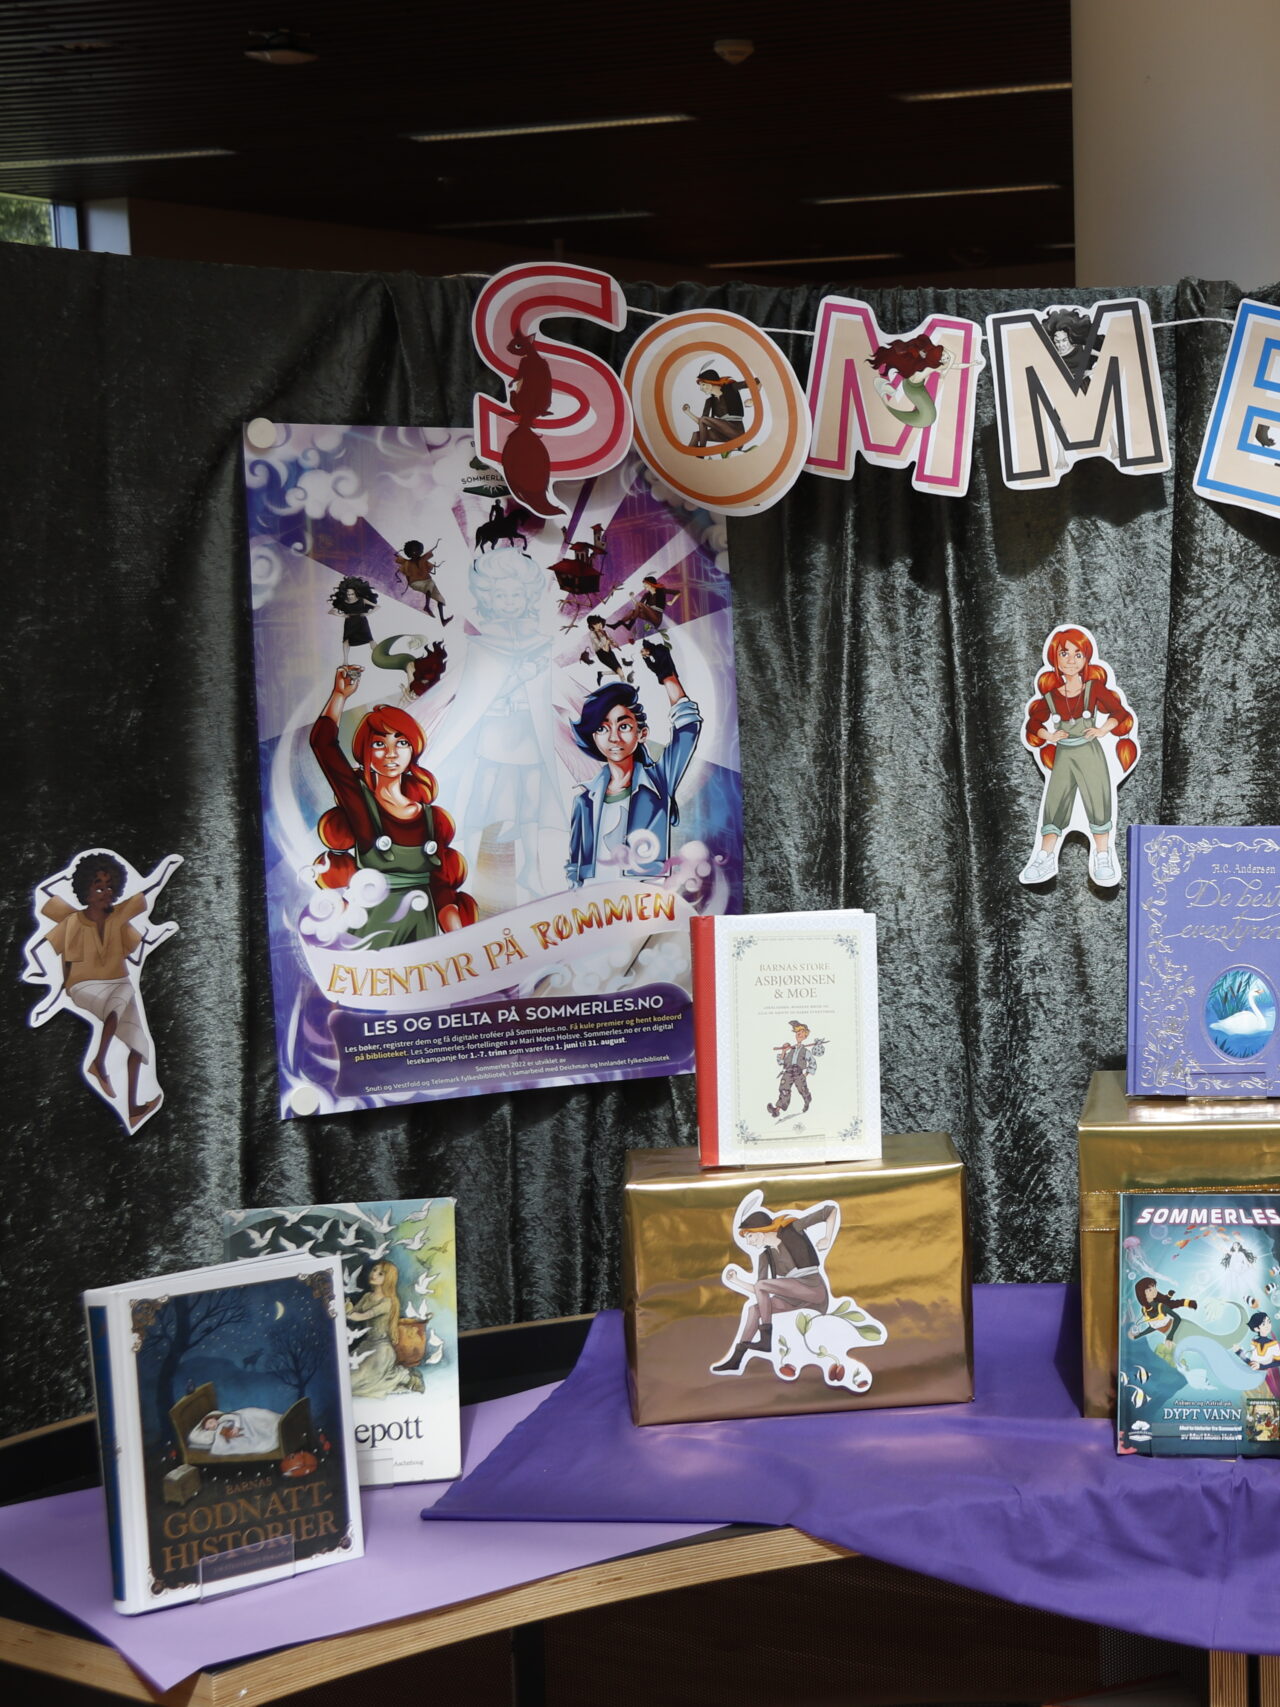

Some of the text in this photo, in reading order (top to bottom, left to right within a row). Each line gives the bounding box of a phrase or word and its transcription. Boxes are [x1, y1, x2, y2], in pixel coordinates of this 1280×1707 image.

[461, 475, 504, 485] SOMMERL
[1232, 863, 1276, 874] Andersen
[1185, 879, 1232, 908] De
[327, 893, 675, 996] EVENTYR PÅ RØMMEN
[754, 974, 836, 987] ASBJØRNSEN
[774, 987, 818, 999] & MOE
[364, 995, 663, 1036] LES OG DELTA PÅ SOMMERLES.NO
[354, 1053, 365, 1062] på
[366, 1050, 409, 1060] biblioteket.
[411, 1048, 423, 1056] Les
[424, 1040, 508, 1054] Sommerles-fortellingen
[536, 1035, 555, 1043] Moen
[556, 1032, 583, 1041] Holsve.
[583, 1028, 633, 1038] Sommerles.no
[652, 1023, 674, 1033] digital
[359, 1043, 382, 1052] bøker,
[383, 1041, 413, 1050] registrer
[415, 1038, 432, 1046] dem
[443, 1035, 451, 1043] få
[451, 1033, 479, 1043] digitale
[505, 1029, 515, 1038] på
[516, 1025, 568, 1036] Sommerles.no.
[596, 1019, 624, 1029] premier
[652, 1013, 682, 1022] kodeord
[406, 1055, 457, 1065] lesekampanje
[470, 1051, 488, 1059] 1.-7.
[488, 1049, 508, 1057] trinn
[563, 1040, 579, 1051] juni
[600, 1037, 628, 1046] august.
[475, 1063, 510, 1072] Sommerles
[511, 1061, 526, 1069] 2022
[1163, 1408, 1242, 1420] DYPT VANN
[354, 1416, 424, 1449] epott
[225, 1477, 273, 1496] BARNAS
[163, 1481, 334, 1540] GODNATT-
[161, 1510, 340, 1573] HISTORIER
